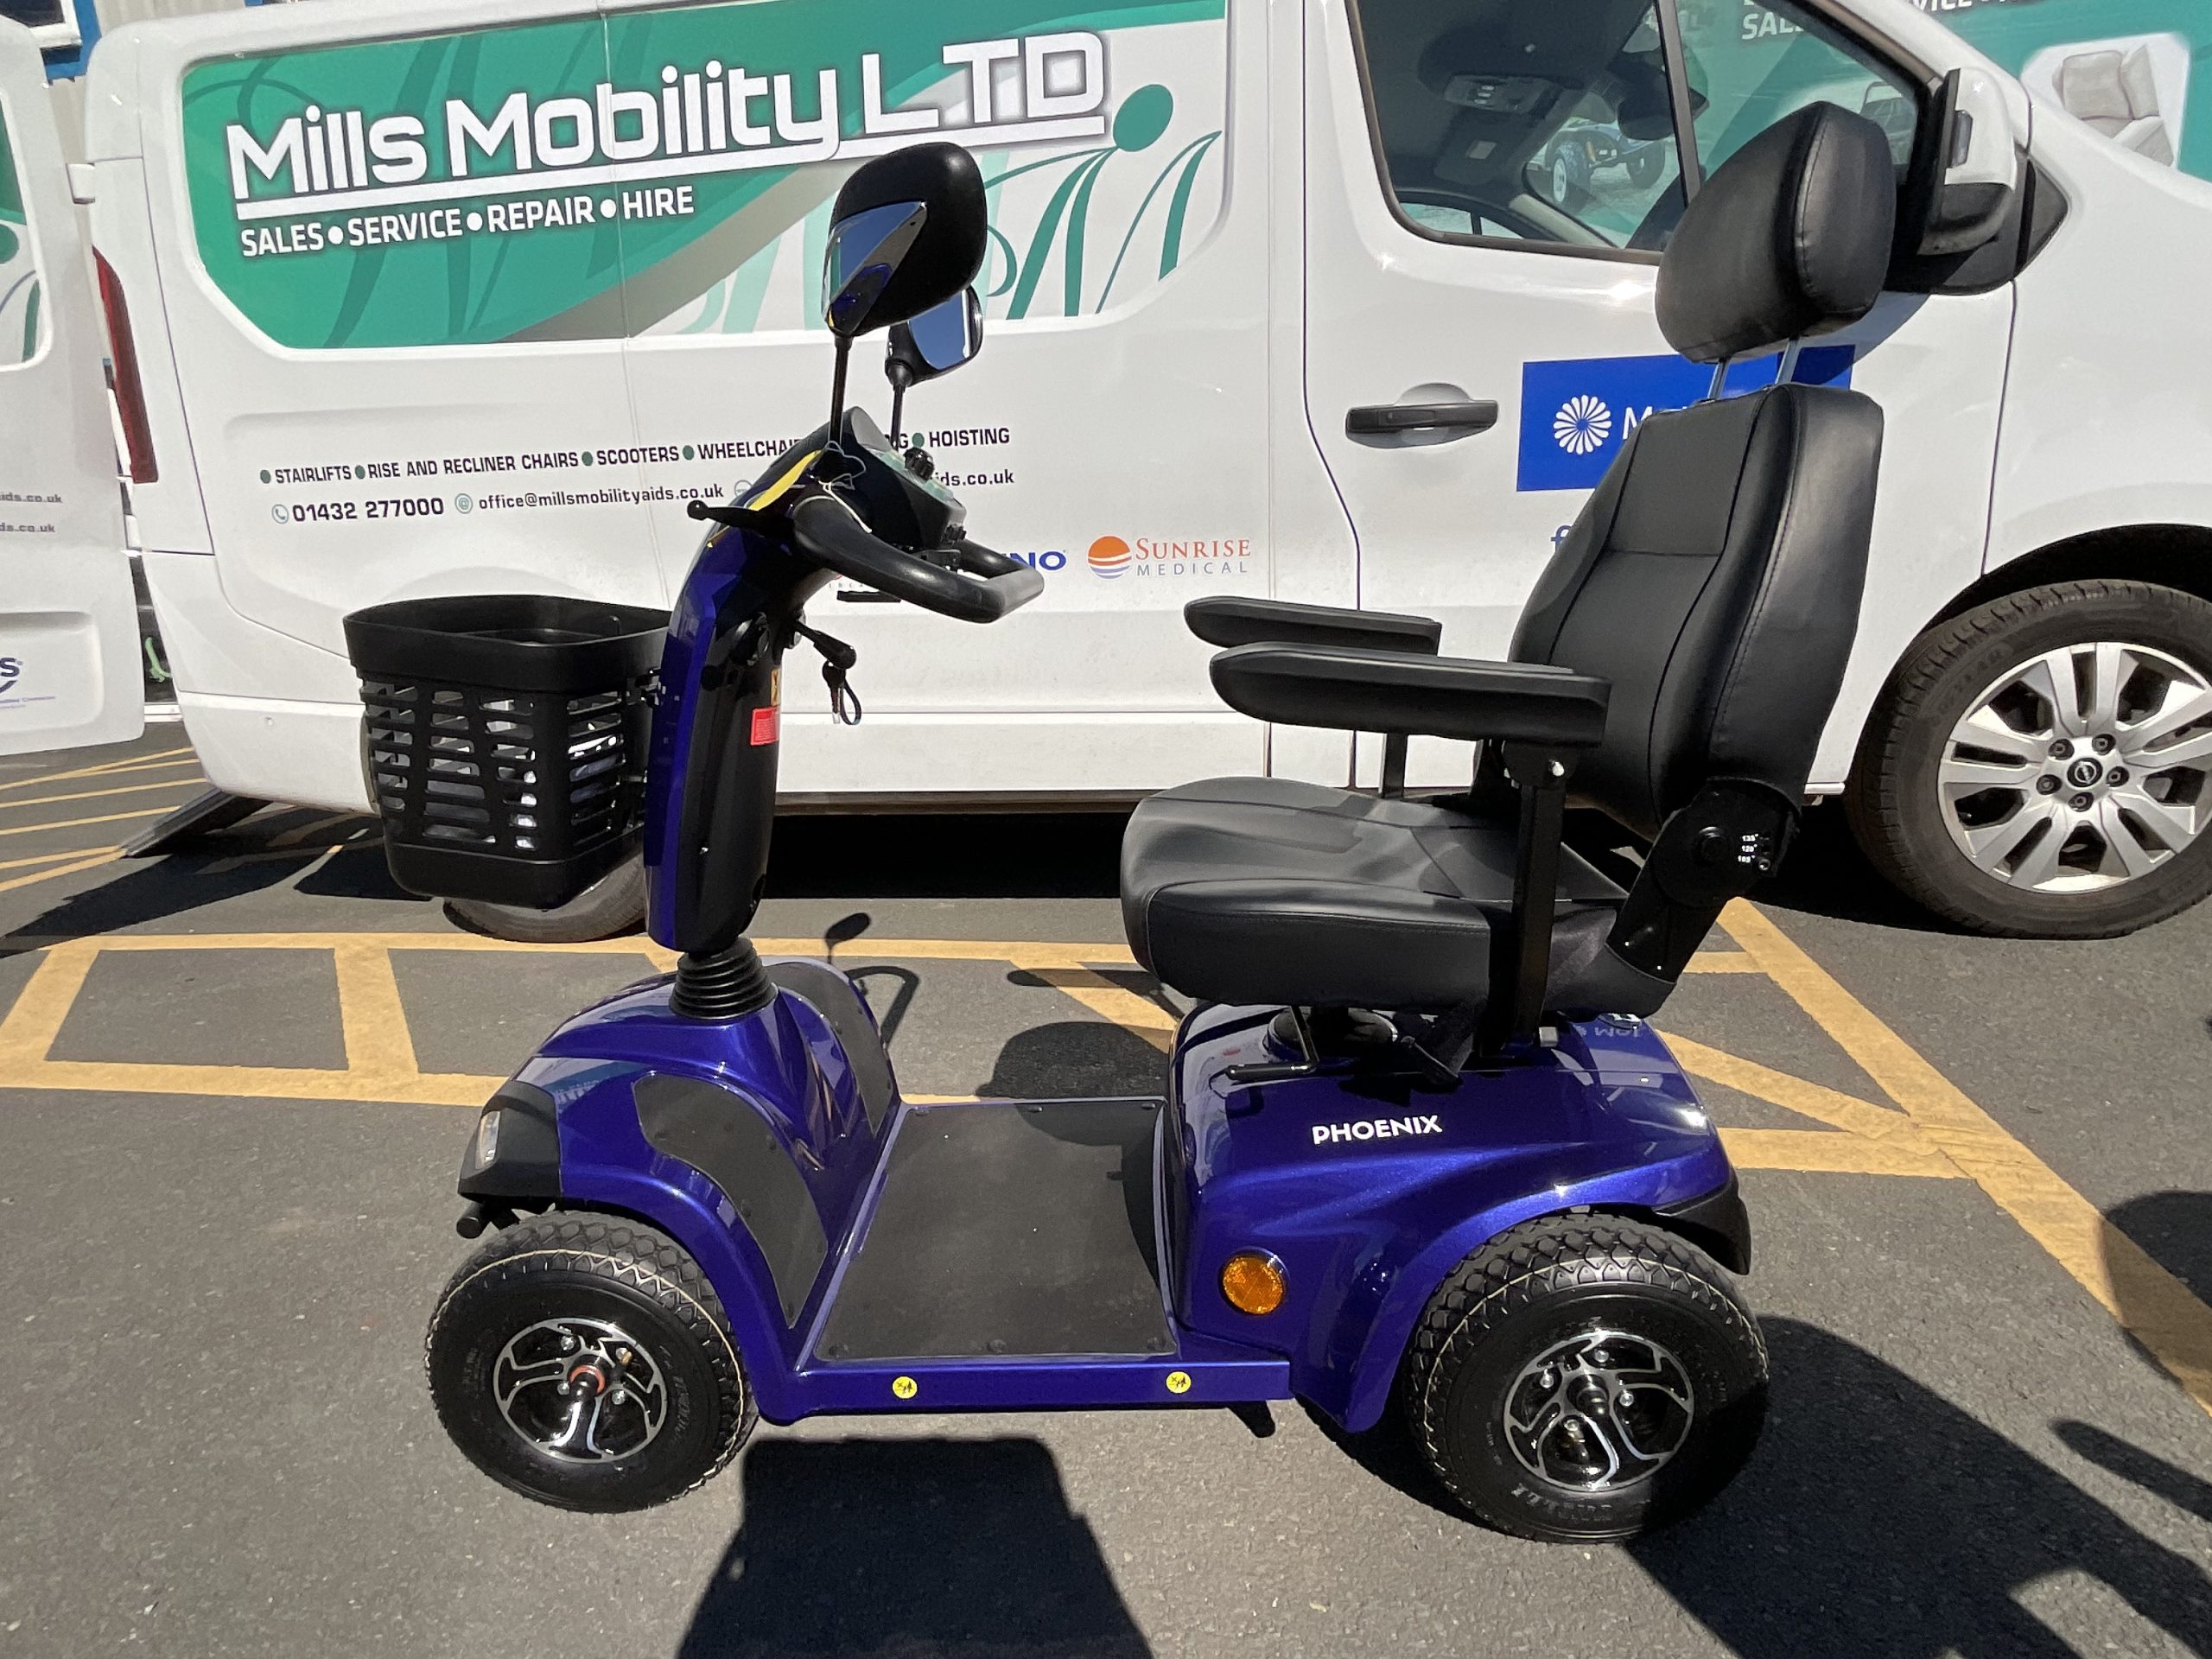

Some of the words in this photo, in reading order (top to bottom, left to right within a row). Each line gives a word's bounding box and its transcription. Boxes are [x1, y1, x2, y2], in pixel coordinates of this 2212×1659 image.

[226, 105, 428, 199] Mills
[446, 60, 840, 176] Mobility
[861, 31, 1104, 135] LTD
[241, 222, 324, 257] SALES
[347, 208, 463, 246] SERVICE
[486, 195, 596, 232] REPAIR
[622, 185, 694, 219] HIRE
[275, 465, 352, 484] STAIRLIFTS
[367, 462, 401, 479] RISE
[406, 460, 438, 476] AND
[443, 455, 516, 474] RECLINER
[521, 449, 579, 469] CHAIRS
[596, 446, 679, 465] SCOOTERS
[929, 428, 1010, 448] HOISTING
[292, 502, 357, 522] 01432
[365, 497, 444, 518] 277000
[479, 483, 724, 510] office@millsmobilityaids.co.uk
[1135, 537, 1251, 560] SUNRISE
[1137, 561, 1248, 576] MEDICAL
[1312, 1115, 1443, 1145] PHOENIX
